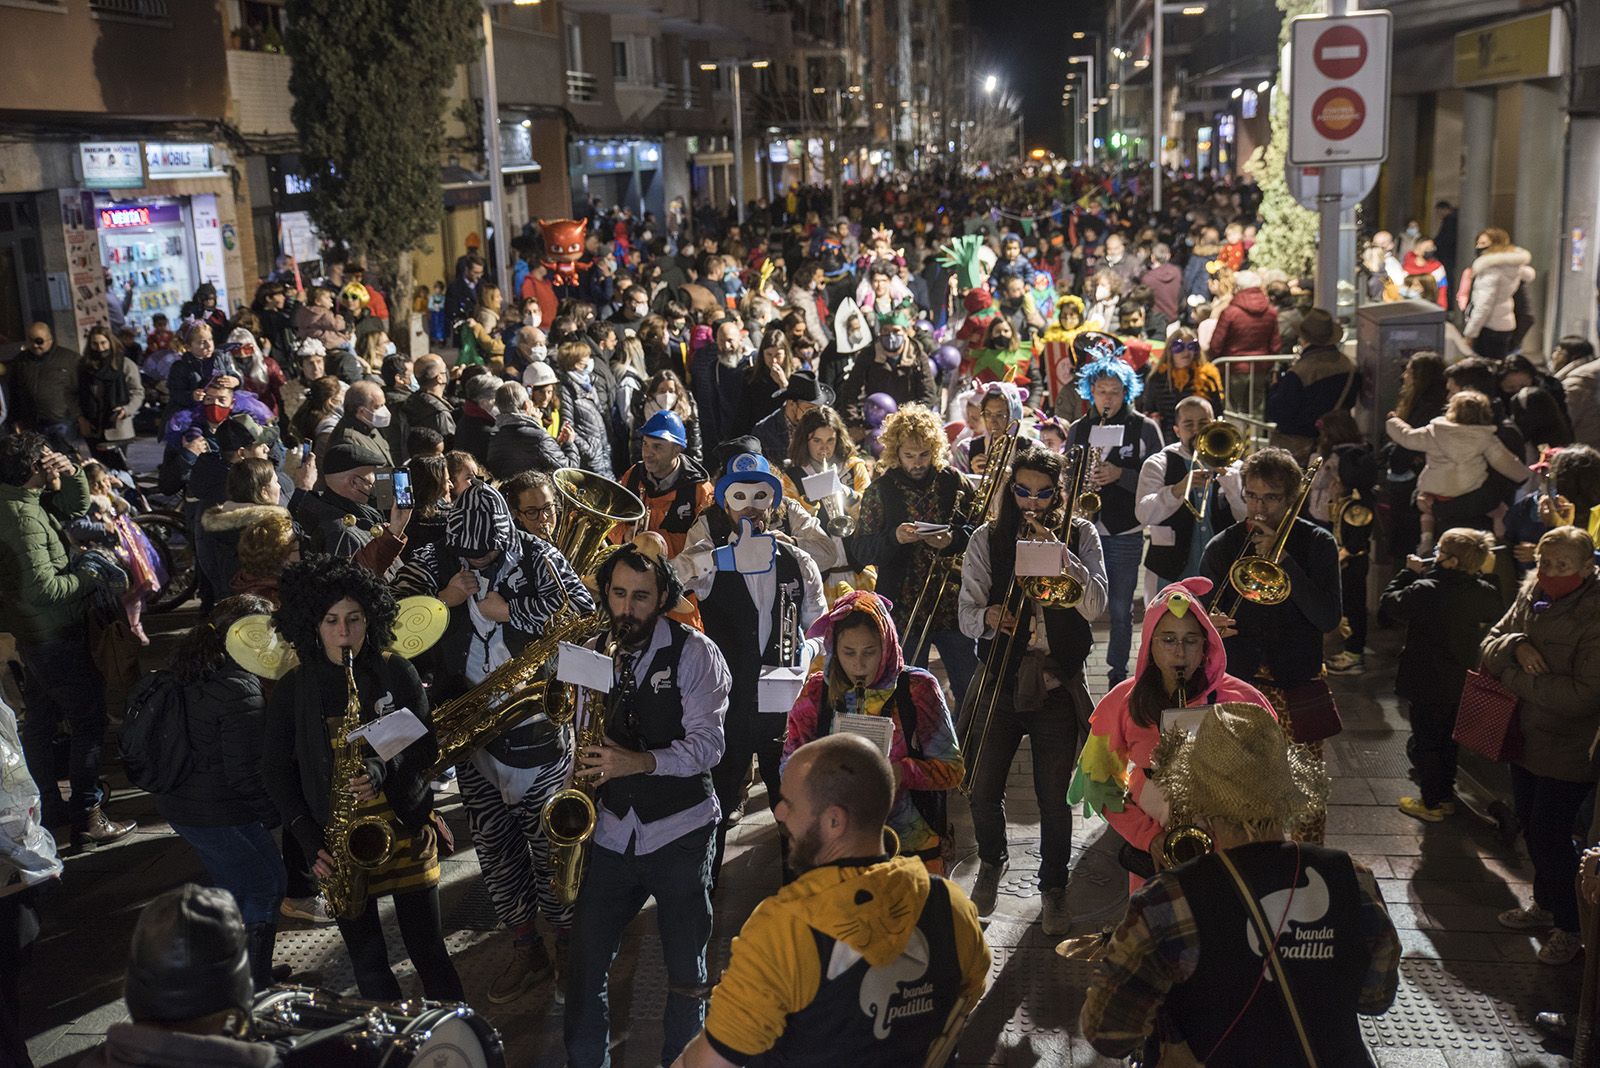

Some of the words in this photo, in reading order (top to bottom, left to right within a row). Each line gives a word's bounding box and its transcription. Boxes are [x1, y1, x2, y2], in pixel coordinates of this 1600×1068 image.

[1295, 926, 1334, 939] banda
[903, 982, 933, 998] banda
[887, 997, 934, 1024] patilla
